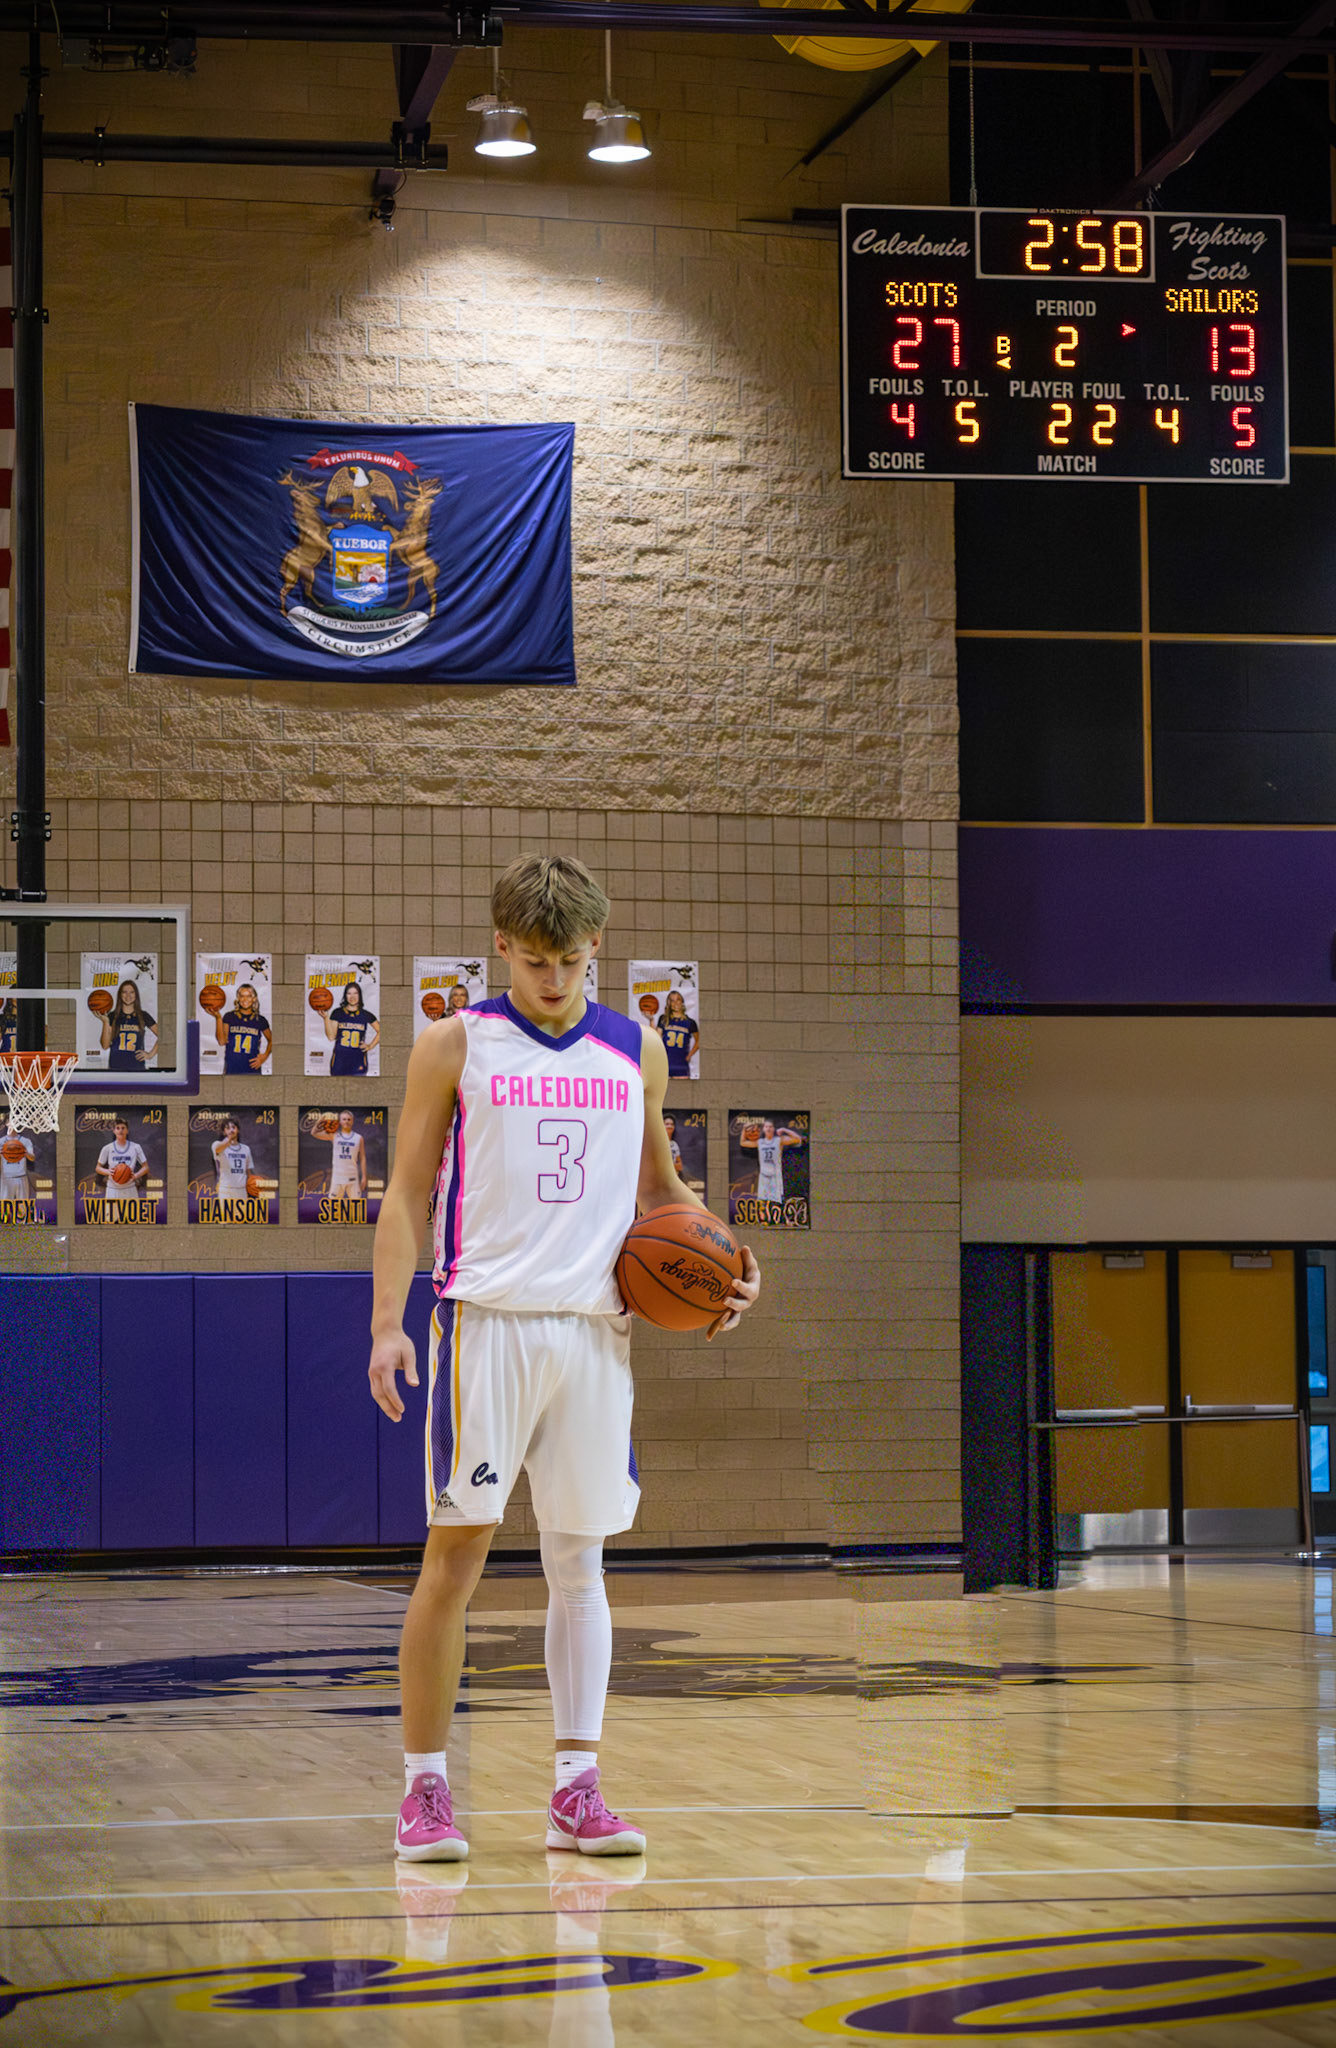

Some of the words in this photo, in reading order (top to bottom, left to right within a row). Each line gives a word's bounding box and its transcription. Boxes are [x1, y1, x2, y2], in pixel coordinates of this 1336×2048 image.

[851, 229, 971, 257] Caledonia
[1025, 219, 1143, 272] 2:58
[1169, 222, 1267, 255] Fighting
[1187, 257, 1250, 282] Scots
[885, 282, 958, 307] SCOTS
[1165, 288, 1259, 313] SAILORS
[1036, 300, 1096, 318] PERIOD
[893, 317, 960, 369] 27
[997, 336, 1011, 354] B
[1054, 326, 1079, 367] 2
[1211, 323, 1255, 376] 13
[869, 378, 924, 396] FOULS
[942, 379, 989, 397] T.O.L.
[1009, 381, 1073, 399] PLAYER
[1083, 383, 1125, 400] FOUL
[1144, 384, 1190, 401] T.O.L.
[1211, 385, 1265, 402] FOULS
[891, 402, 915, 438] 4
[955, 402, 980, 443] 5
[1155, 408, 1179, 443] 4
[1231, 407, 1256, 447] 5
[331, 452, 373, 463] PLURIBUS
[373, 455, 401, 469] UNUM
[869, 452, 925, 469] SCORE
[1038, 455, 1096, 473] MATCH
[1210, 458, 1265, 475] SCORE
[333, 537, 388, 551] TUEBOR
[307, 627, 412, 654] CIRCUMSPICE
[92, 972, 119, 988] KING
[204, 971, 238, 986] VELDT
[308, 971, 357, 989] HILEMAN
[118, 1032, 138, 1051] 12
[233, 1034, 252, 1054] 14
[340, 1030, 360, 1049] 20
[666, 1031, 684, 1048] 34
[491, 1075, 629, 1112] CALEDONIA
[143, 1110, 162, 1124] #12
[538, 1119, 587, 1203] 3
[85, 1198, 158, 1224] WITVOET
[199, 1197, 269, 1224] HANSON
[318, 1197, 367, 1224] SENTI
[659, 1257, 730, 1304] Rawlings
